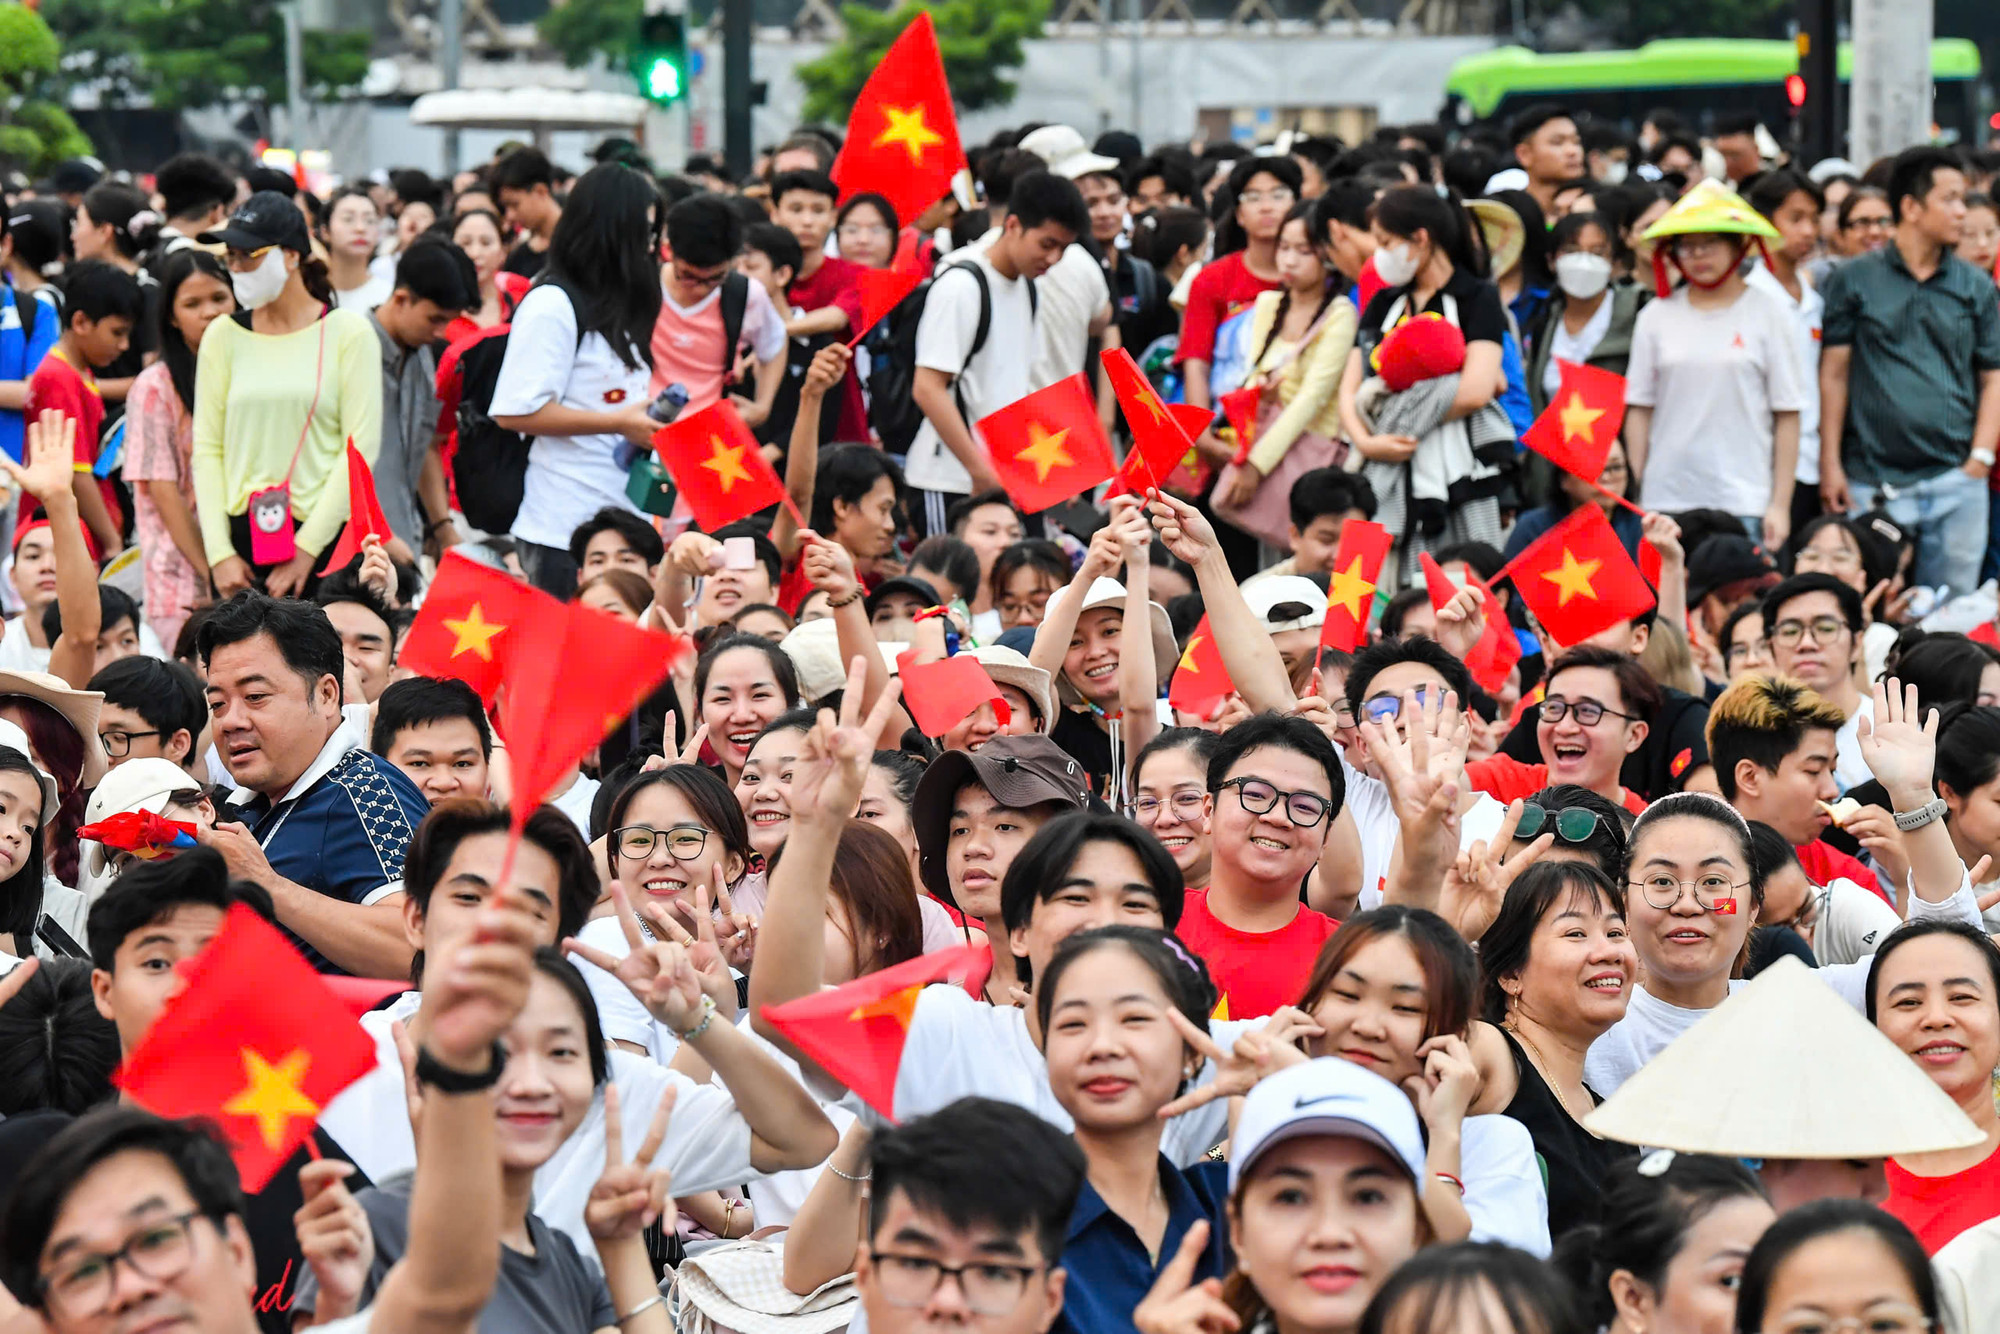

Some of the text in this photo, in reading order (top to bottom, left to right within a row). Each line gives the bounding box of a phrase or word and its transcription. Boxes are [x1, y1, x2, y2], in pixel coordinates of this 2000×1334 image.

[360, 784, 370, 793] YD
[367, 800, 377, 808] YD
[383, 803, 394, 811] YD
[374, 815, 385, 824] YD
[390, 820, 401, 828] YD
[382, 832, 392, 841] YD
[398, 836, 408, 844] YD
[389, 848, 400, 857] YD
[389, 872, 400, 880] YD
